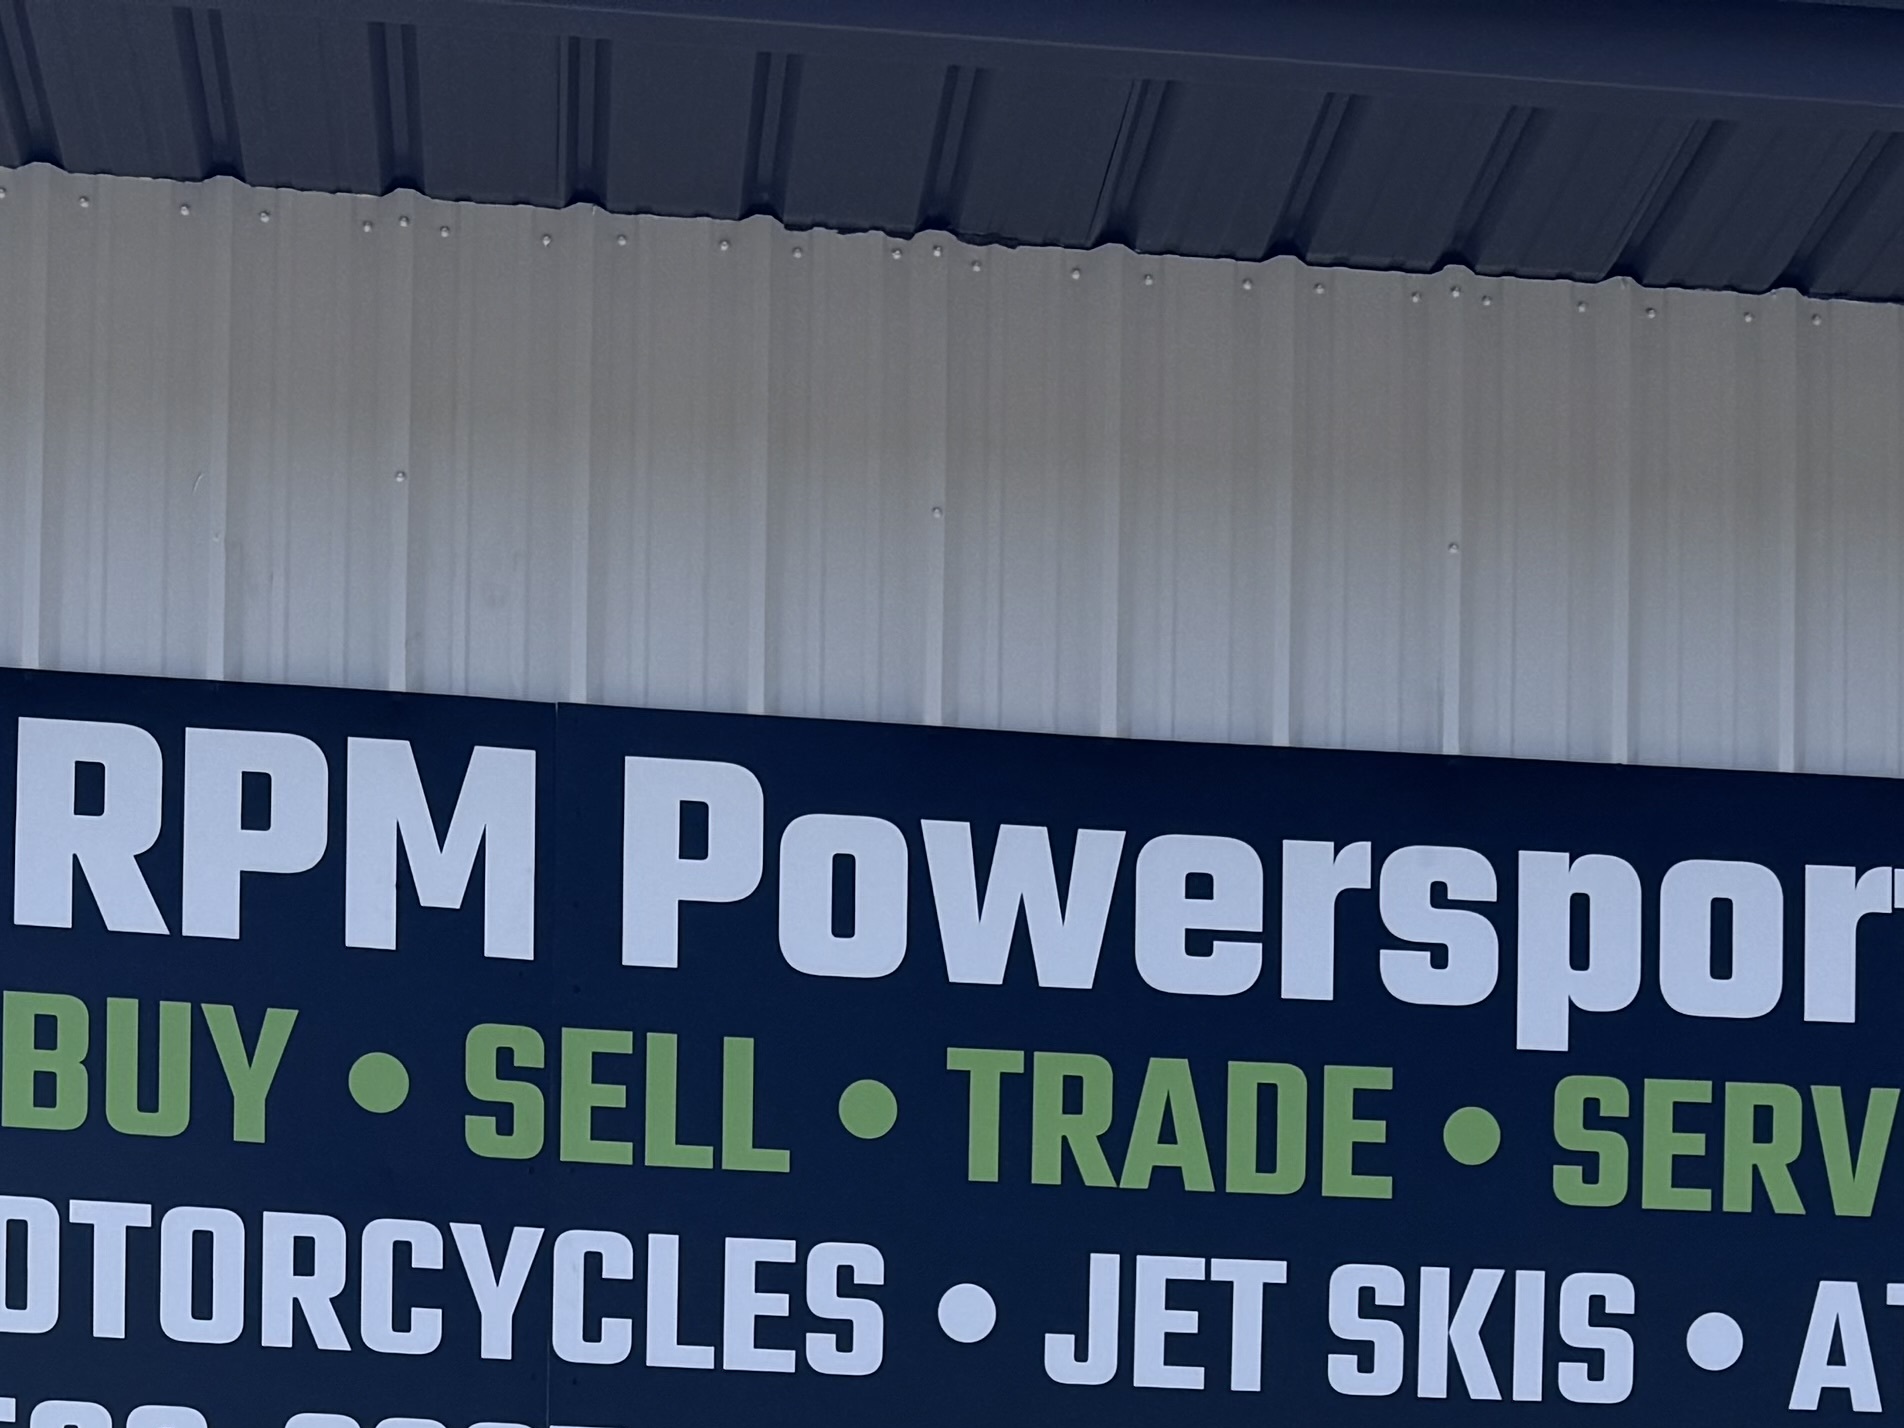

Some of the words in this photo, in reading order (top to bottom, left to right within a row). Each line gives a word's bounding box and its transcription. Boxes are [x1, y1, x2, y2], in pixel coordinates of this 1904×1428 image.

[14, 716, 537, 961] RPM
[1, 990, 299, 1144] BUY
[464, 1023, 792, 1173] SELL
[946, 1047, 1394, 1199] TRADE
[1043, 1253, 1288, 1391] JET
[1326, 1263, 1636, 1405] SKIS
